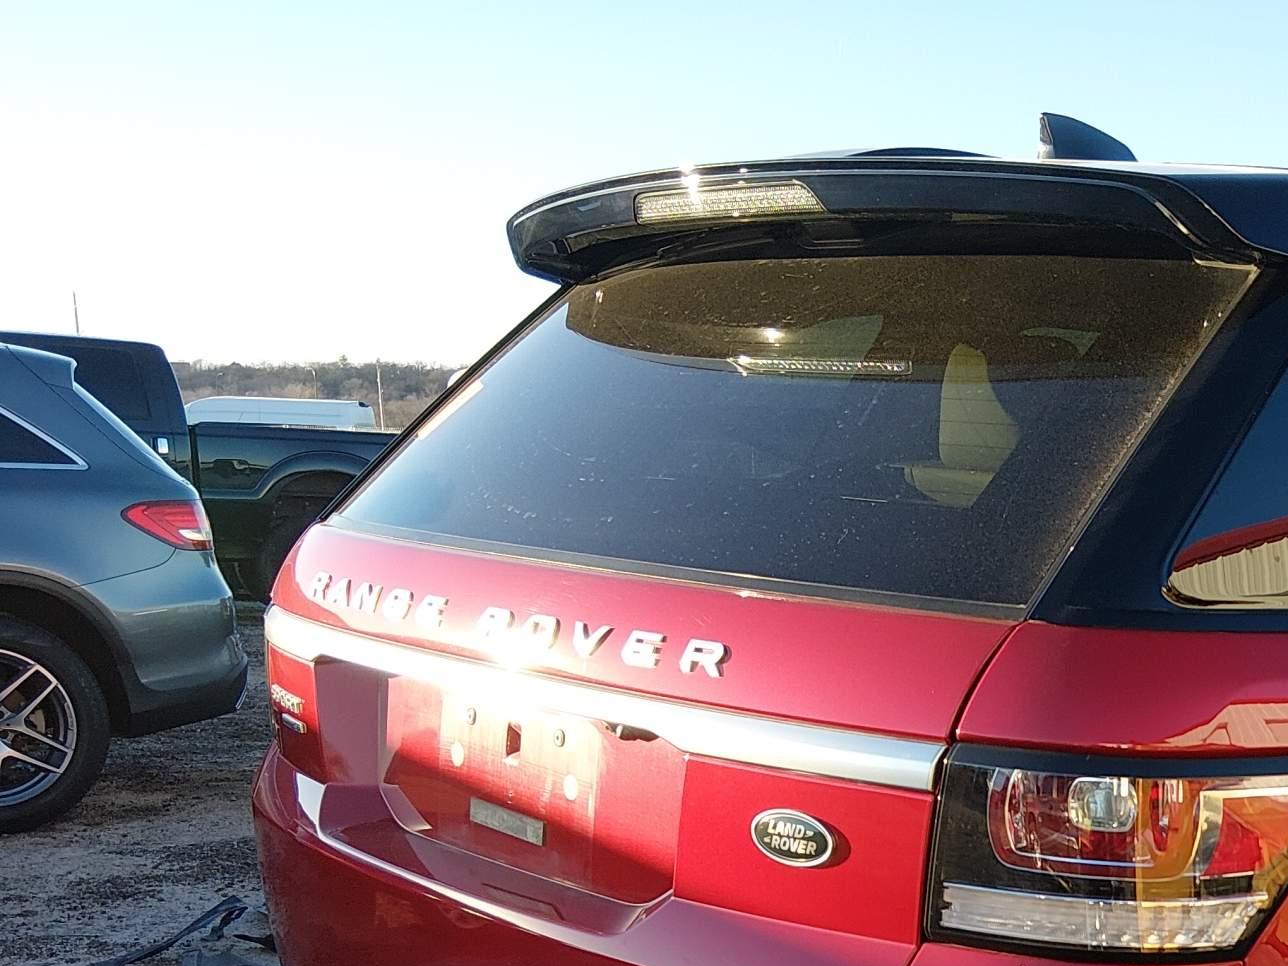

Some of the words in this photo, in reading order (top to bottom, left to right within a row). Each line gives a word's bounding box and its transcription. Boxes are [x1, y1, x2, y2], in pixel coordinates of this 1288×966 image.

[309, 570, 449, 630] RANGE
[478, 605, 732, 678] ROVER
[767, 819, 805, 838] LAND
[770, 836, 817, 855] ROVER
